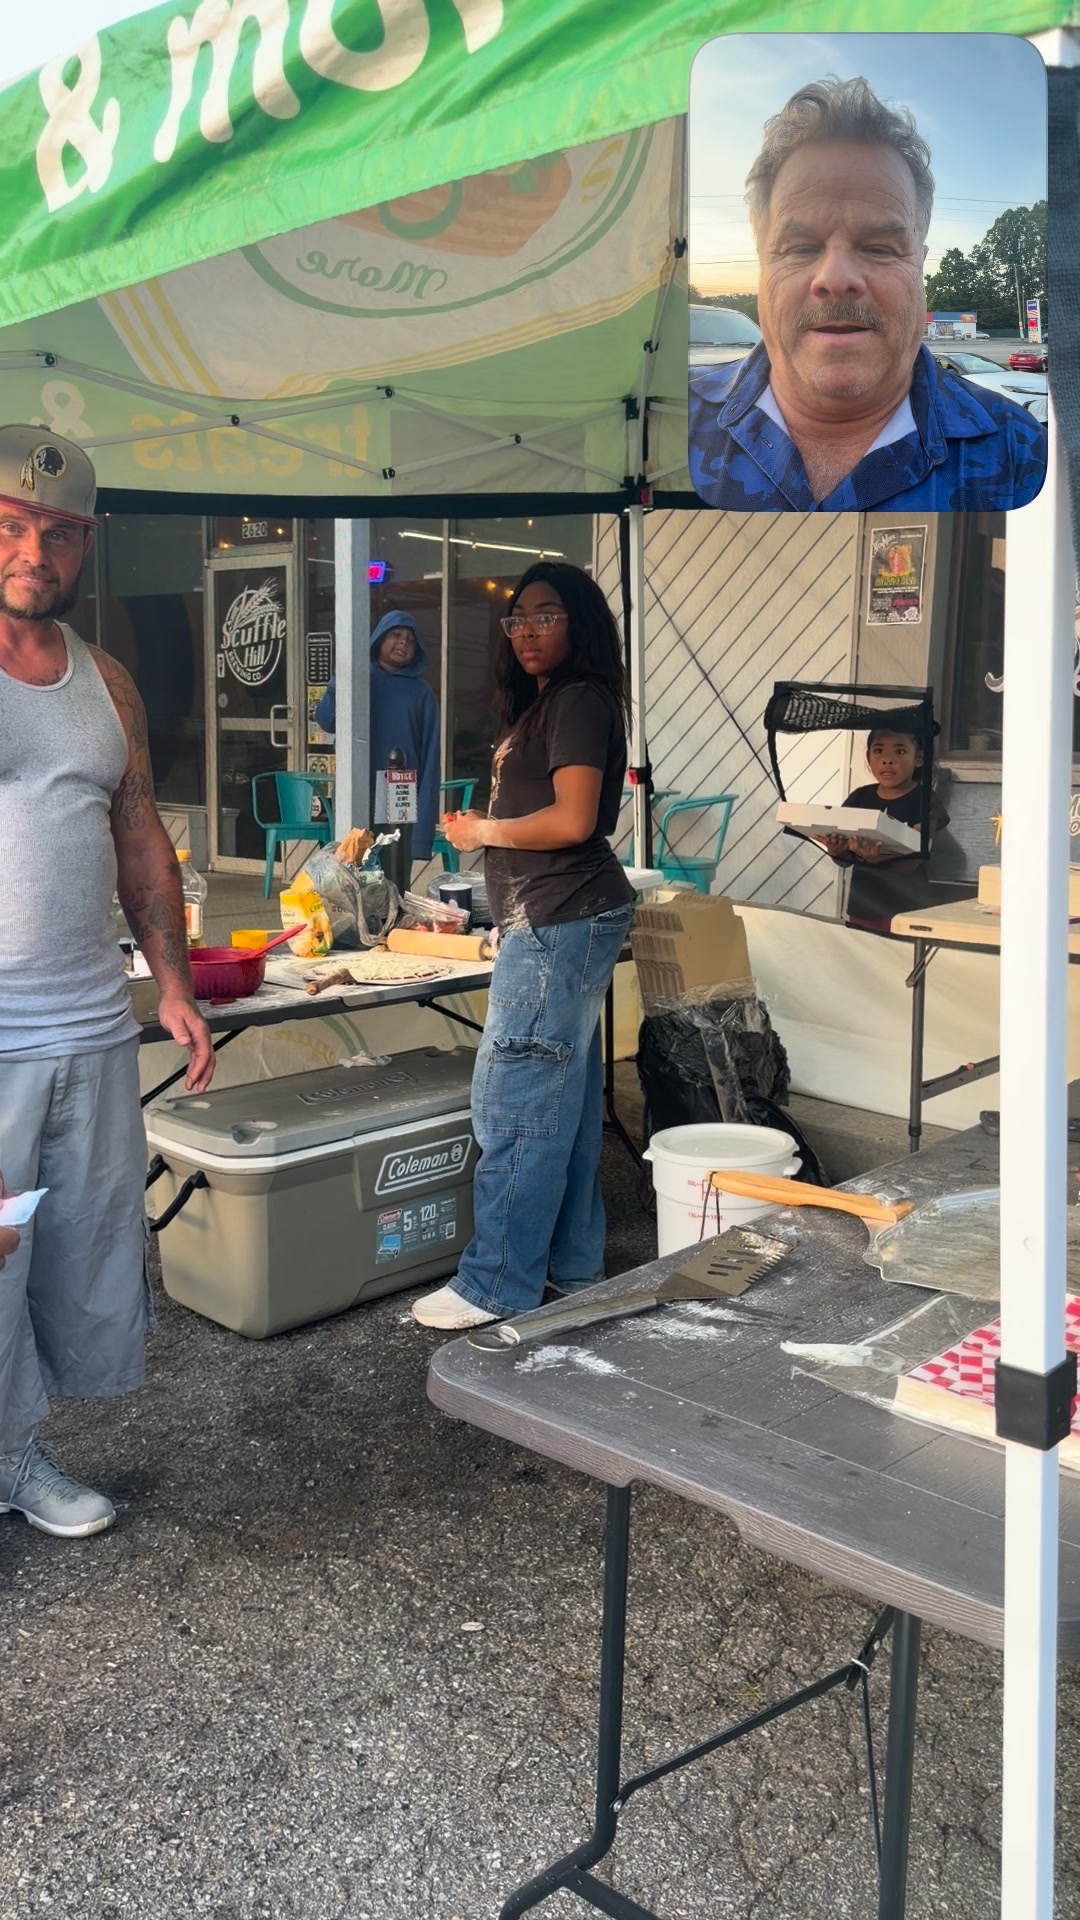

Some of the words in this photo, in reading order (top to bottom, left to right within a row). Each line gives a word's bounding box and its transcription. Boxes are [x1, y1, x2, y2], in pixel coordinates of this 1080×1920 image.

[36, 32, 120, 213] &
[154, 0, 506, 163] mo
[242, 523, 267, 538] 2620
[221, 612, 287, 649] Scuffle
[244, 644, 266, 668] Hill
[388, 1152, 449, 1180] Coleman
[403, 1210, 413, 1232] 5
[420, 1203, 437, 1222] 120
